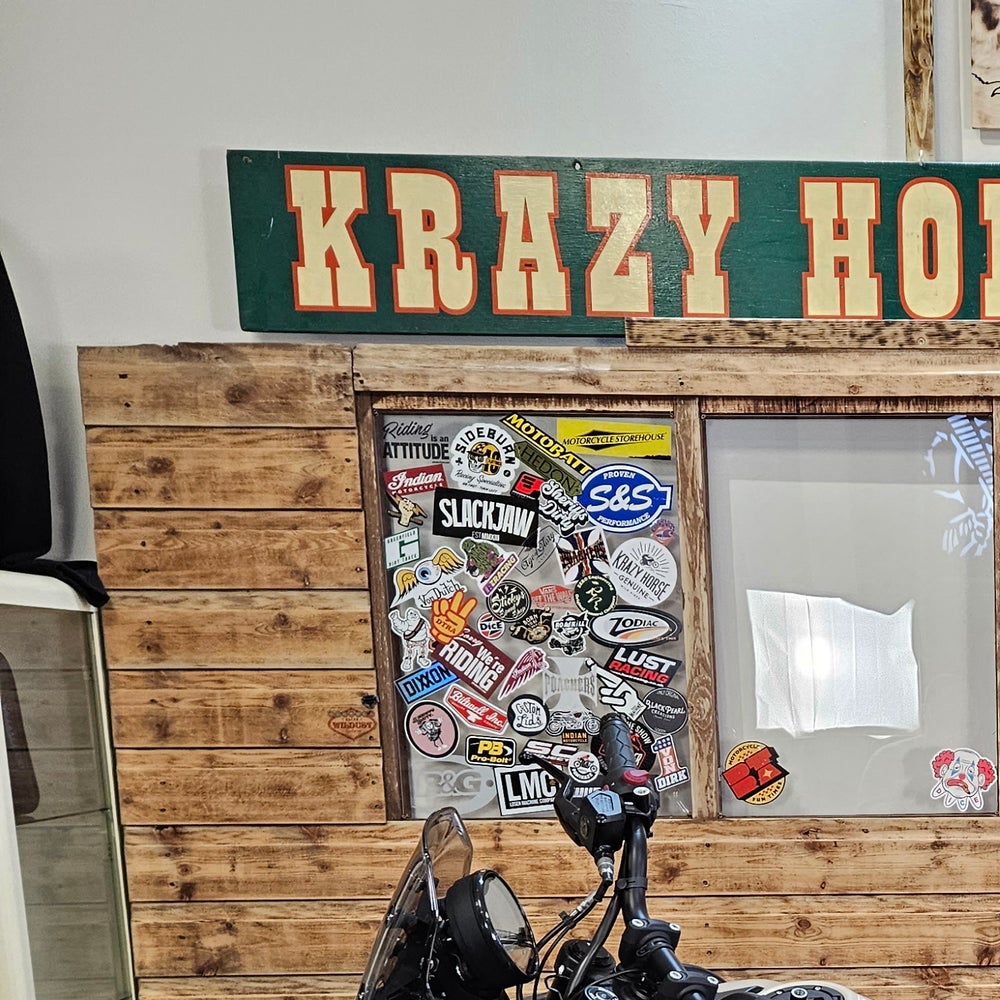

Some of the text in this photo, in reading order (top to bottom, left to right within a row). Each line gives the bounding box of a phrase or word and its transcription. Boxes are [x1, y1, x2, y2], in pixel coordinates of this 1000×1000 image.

[284, 165, 740, 316] KRAZY
[384, 421, 433, 440] Riding
[562, 432, 665, 446] MOTORCYCLE STOREHOUSE
[383, 442, 449, 459] ATTITUDE
[455, 427, 516, 465] SIDEBURN
[506, 413, 592, 475] MOTOBATT
[387, 471, 443, 492] Indian
[520, 446, 575, 493] HEDON
[602, 470, 636, 480] PROVEN
[586, 483, 657, 513] S&S
[438, 498, 536, 538] SLACKJAW
[597, 513, 650, 527] PERFORMANCE
[612, 550, 644, 579] KRAZY
[639, 572, 671, 601] HORSE
[618, 574, 650, 600] GENUINE
[609, 616, 659, 637] ZODIAC
[438, 639, 499, 692] RIDING
[476, 645, 505, 675] We're
[608, 661, 670, 685] RACING
[615, 647, 677, 674] LUST
[402, 662, 452, 698] DIXXON
[477, 740, 504, 755] PB
[635, 724, 652, 745] SHOW
[524, 740, 578, 758] SC
[505, 770, 557, 801] LMC
[658, 771, 688, 789] DIRK
